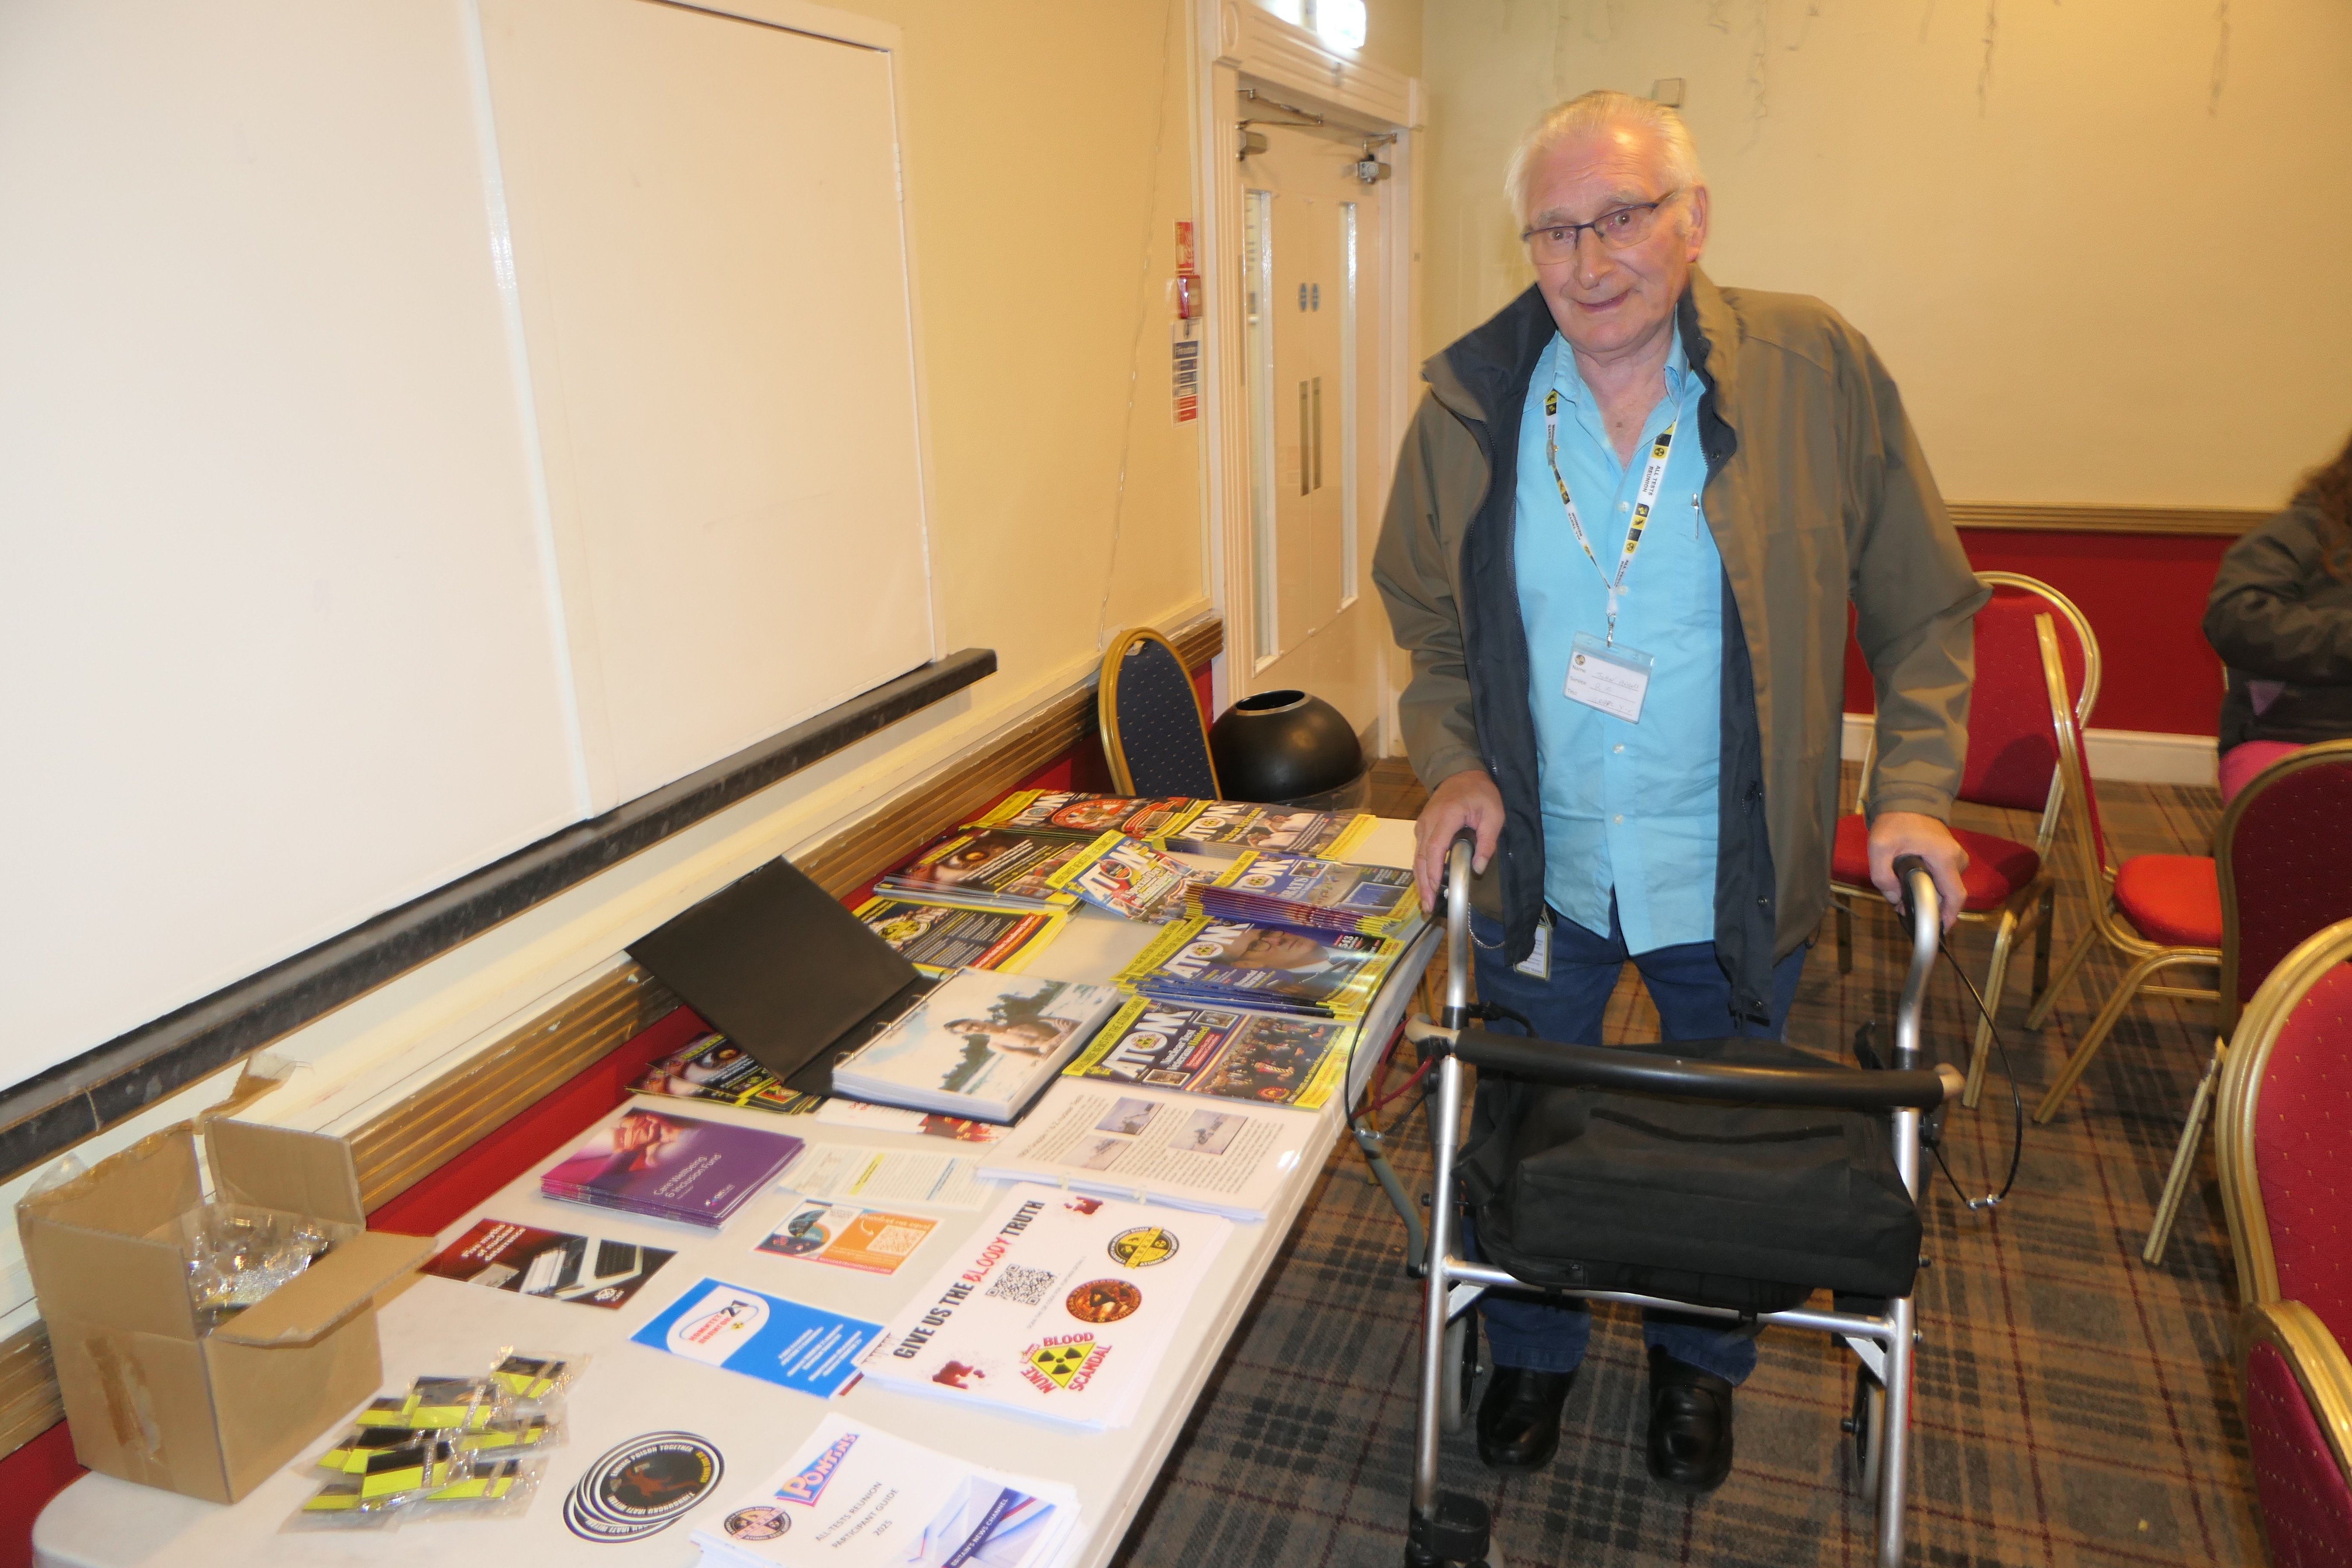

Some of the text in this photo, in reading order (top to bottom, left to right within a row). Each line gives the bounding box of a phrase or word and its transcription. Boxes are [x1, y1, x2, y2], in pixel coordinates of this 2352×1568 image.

[1642, 466, 1654, 492] REUNION
[1648, 479, 1657, 496] TESTS
[1572, 512, 1583, 536] REUNION
[1570, 676, 1586, 685] Service
[1178, 803, 1246, 841] ATOM
[1234, 807, 1263, 829] Veterans
[1127, 871, 1155, 897] Special
[1146, 865, 1165, 881] Day
[1232, 859, 1296, 891] TOM
[1285, 876, 1309, 899] BRATS
[1003, 926, 1026, 943] Academy
[1162, 923, 1251, 978] ATOM
[1335, 935, 1357, 948] 543
[1152, 950, 1171, 958] NEWS
[1071, 998, 1146, 1072] WORLDWIDE NEWS FOR THE ATOMIC FAMILY
[1102, 1007, 1194, 1080] ATOM
[1160, 1029, 1197, 1064] Nuclear Test
[1167, 1044, 1196, 1070] Veterans
[1185, 1026, 1212, 1046] United
[1317, 1057, 1340, 1081] Membership
[1054, 1106, 1076, 1122] nuclear
[1069, 1094, 1086, 1105] Tests
[650, 1182, 675, 1195] Care
[668, 1156, 710, 1182] Wellbeing
[671, 1168, 707, 1191] Inclusion
[700, 1155, 724, 1168] Fund
[460, 1224, 508, 1257] Five myths
[482, 1228, 529, 1261] deterrence
[484, 1226, 518, 1249] nuclear
[1129, 1228, 1159, 1265] LABRATS
[891, 1199, 1046, 1359] GIVE US THE BLOODY TRUTH
[1059, 1270, 1075, 1286] FURTHER
[718, 1299, 750, 1317] 21
[687, 1314, 723, 1341] КОМИТЕТ
[1020, 1332, 1113, 1393] NUKE BLOOD SCANDAL
[610, 1459, 631, 1477] ENDING
[631, 1447, 657, 1461] POISON
[816, 1482, 882, 1541] ALL-TESTS REUNION
[832, 1488, 898, 1547] PARTICIPANT GUIDE
[873, 1520, 893, 1536] 2025
[949, 1498, 1010, 1566] BRITAIN'S NEWS CHANNEL
